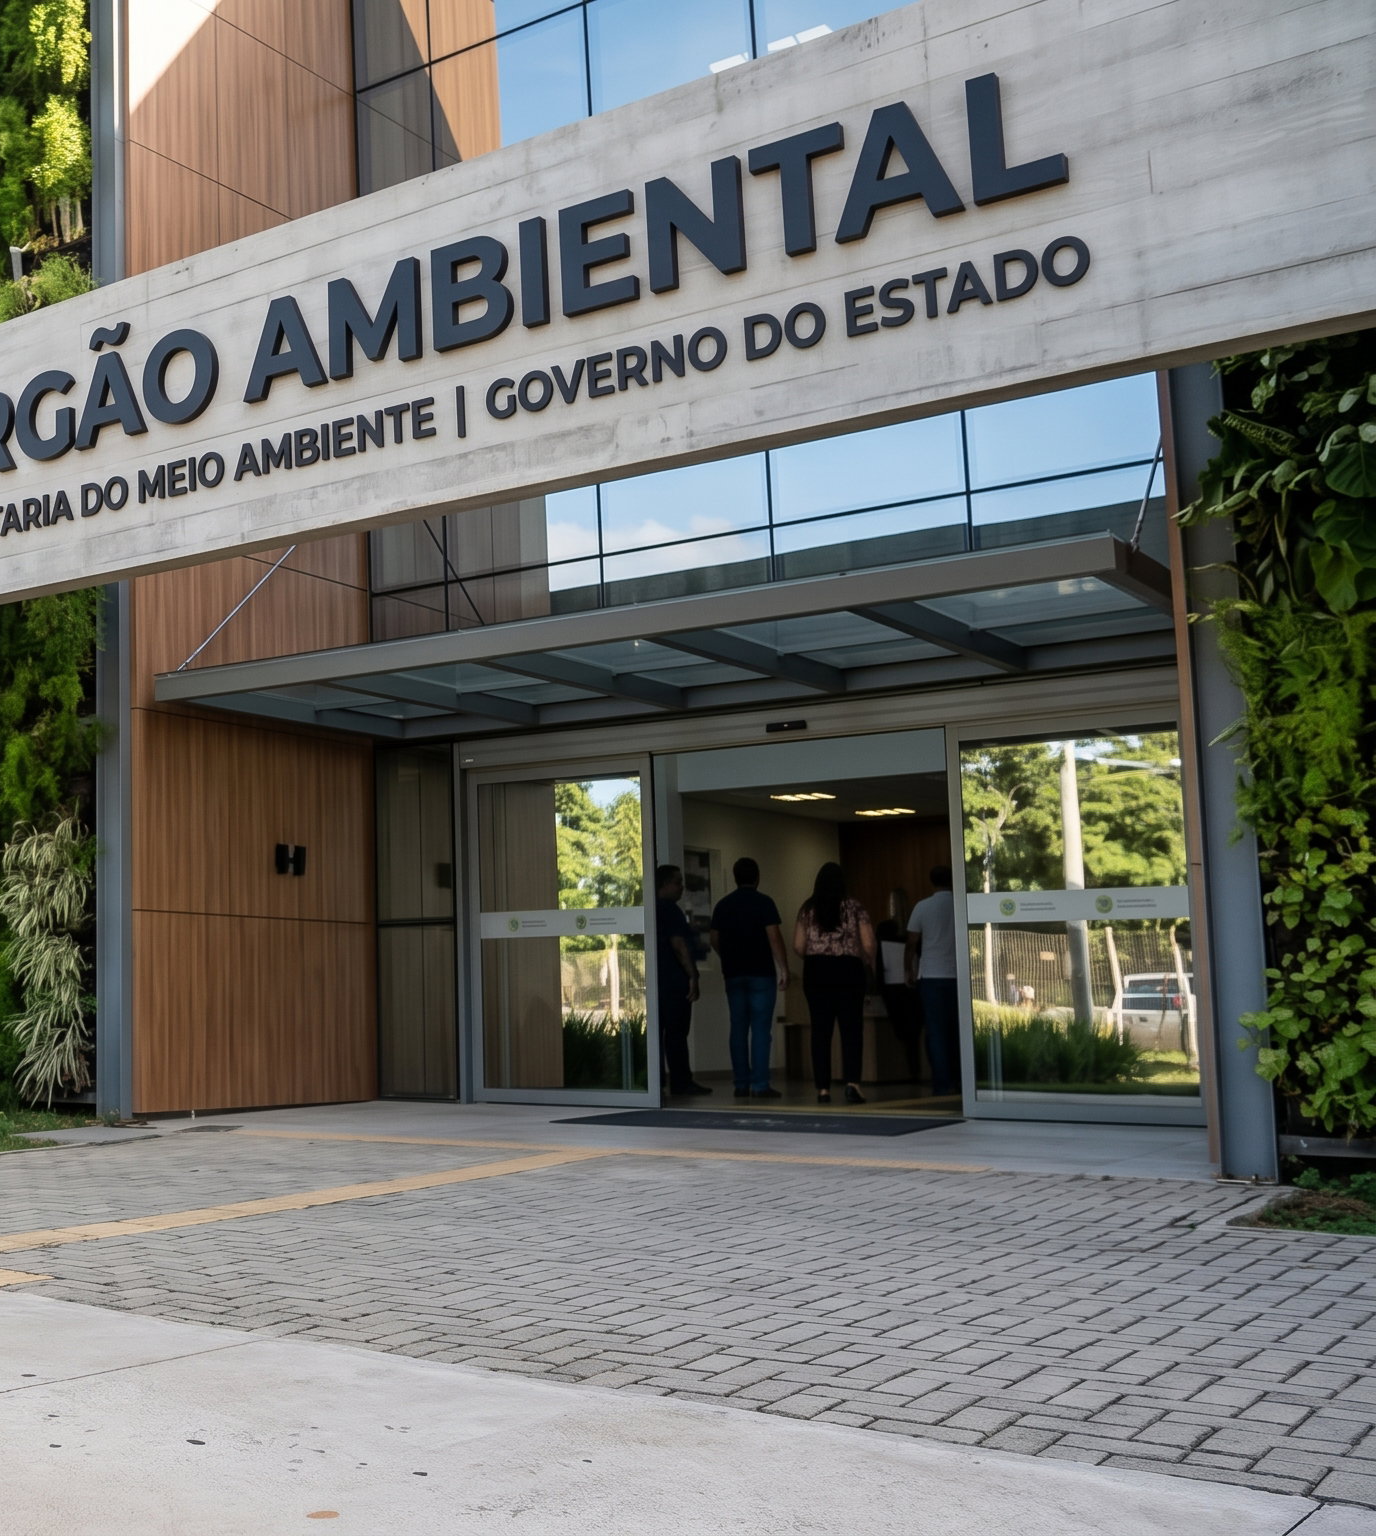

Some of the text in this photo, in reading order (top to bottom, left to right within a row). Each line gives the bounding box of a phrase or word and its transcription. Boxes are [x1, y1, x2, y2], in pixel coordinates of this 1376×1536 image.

[80, 475, 130, 518] DO
[137, 451, 226, 505] MEIO
[233, 396, 437, 482] AMBIENTE
[485, 326, 729, 421] GOVERNO
[743, 301, 827, 363] DO
[843, 235, 1091, 340] ESTADO
[242, 71, 1070, 406] AMBIENTAL
